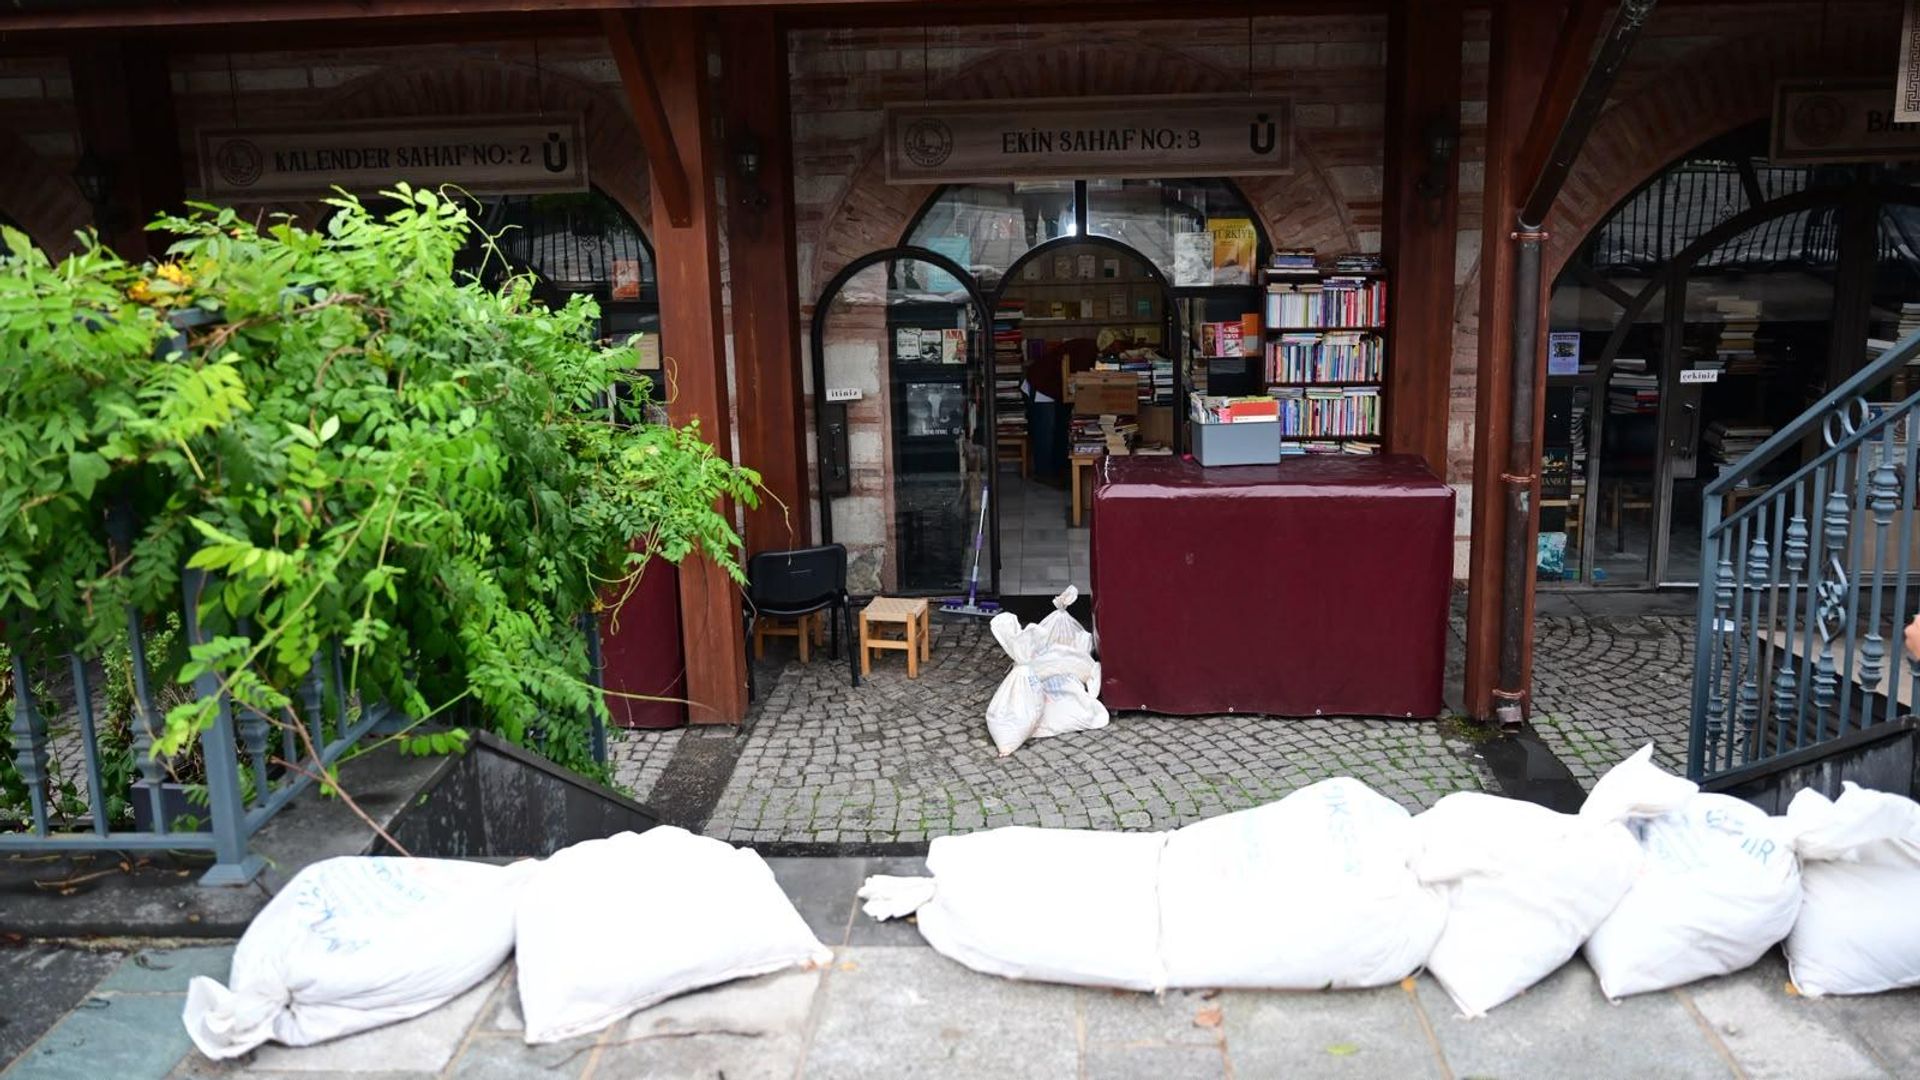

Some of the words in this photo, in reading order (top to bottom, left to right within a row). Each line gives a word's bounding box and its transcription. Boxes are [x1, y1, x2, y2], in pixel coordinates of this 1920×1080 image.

[1001, 128, 1053, 154] EKİN
[1060, 127, 1135, 153] SAHAF
[1141, 128, 1181, 150] NO:
[1188, 128, 1201, 150] 3
[274, 147, 391, 172] KALENDER
[397, 145, 467, 169] SAHAF
[474, 144, 513, 166] NO:
[519, 144, 532, 164] 2
